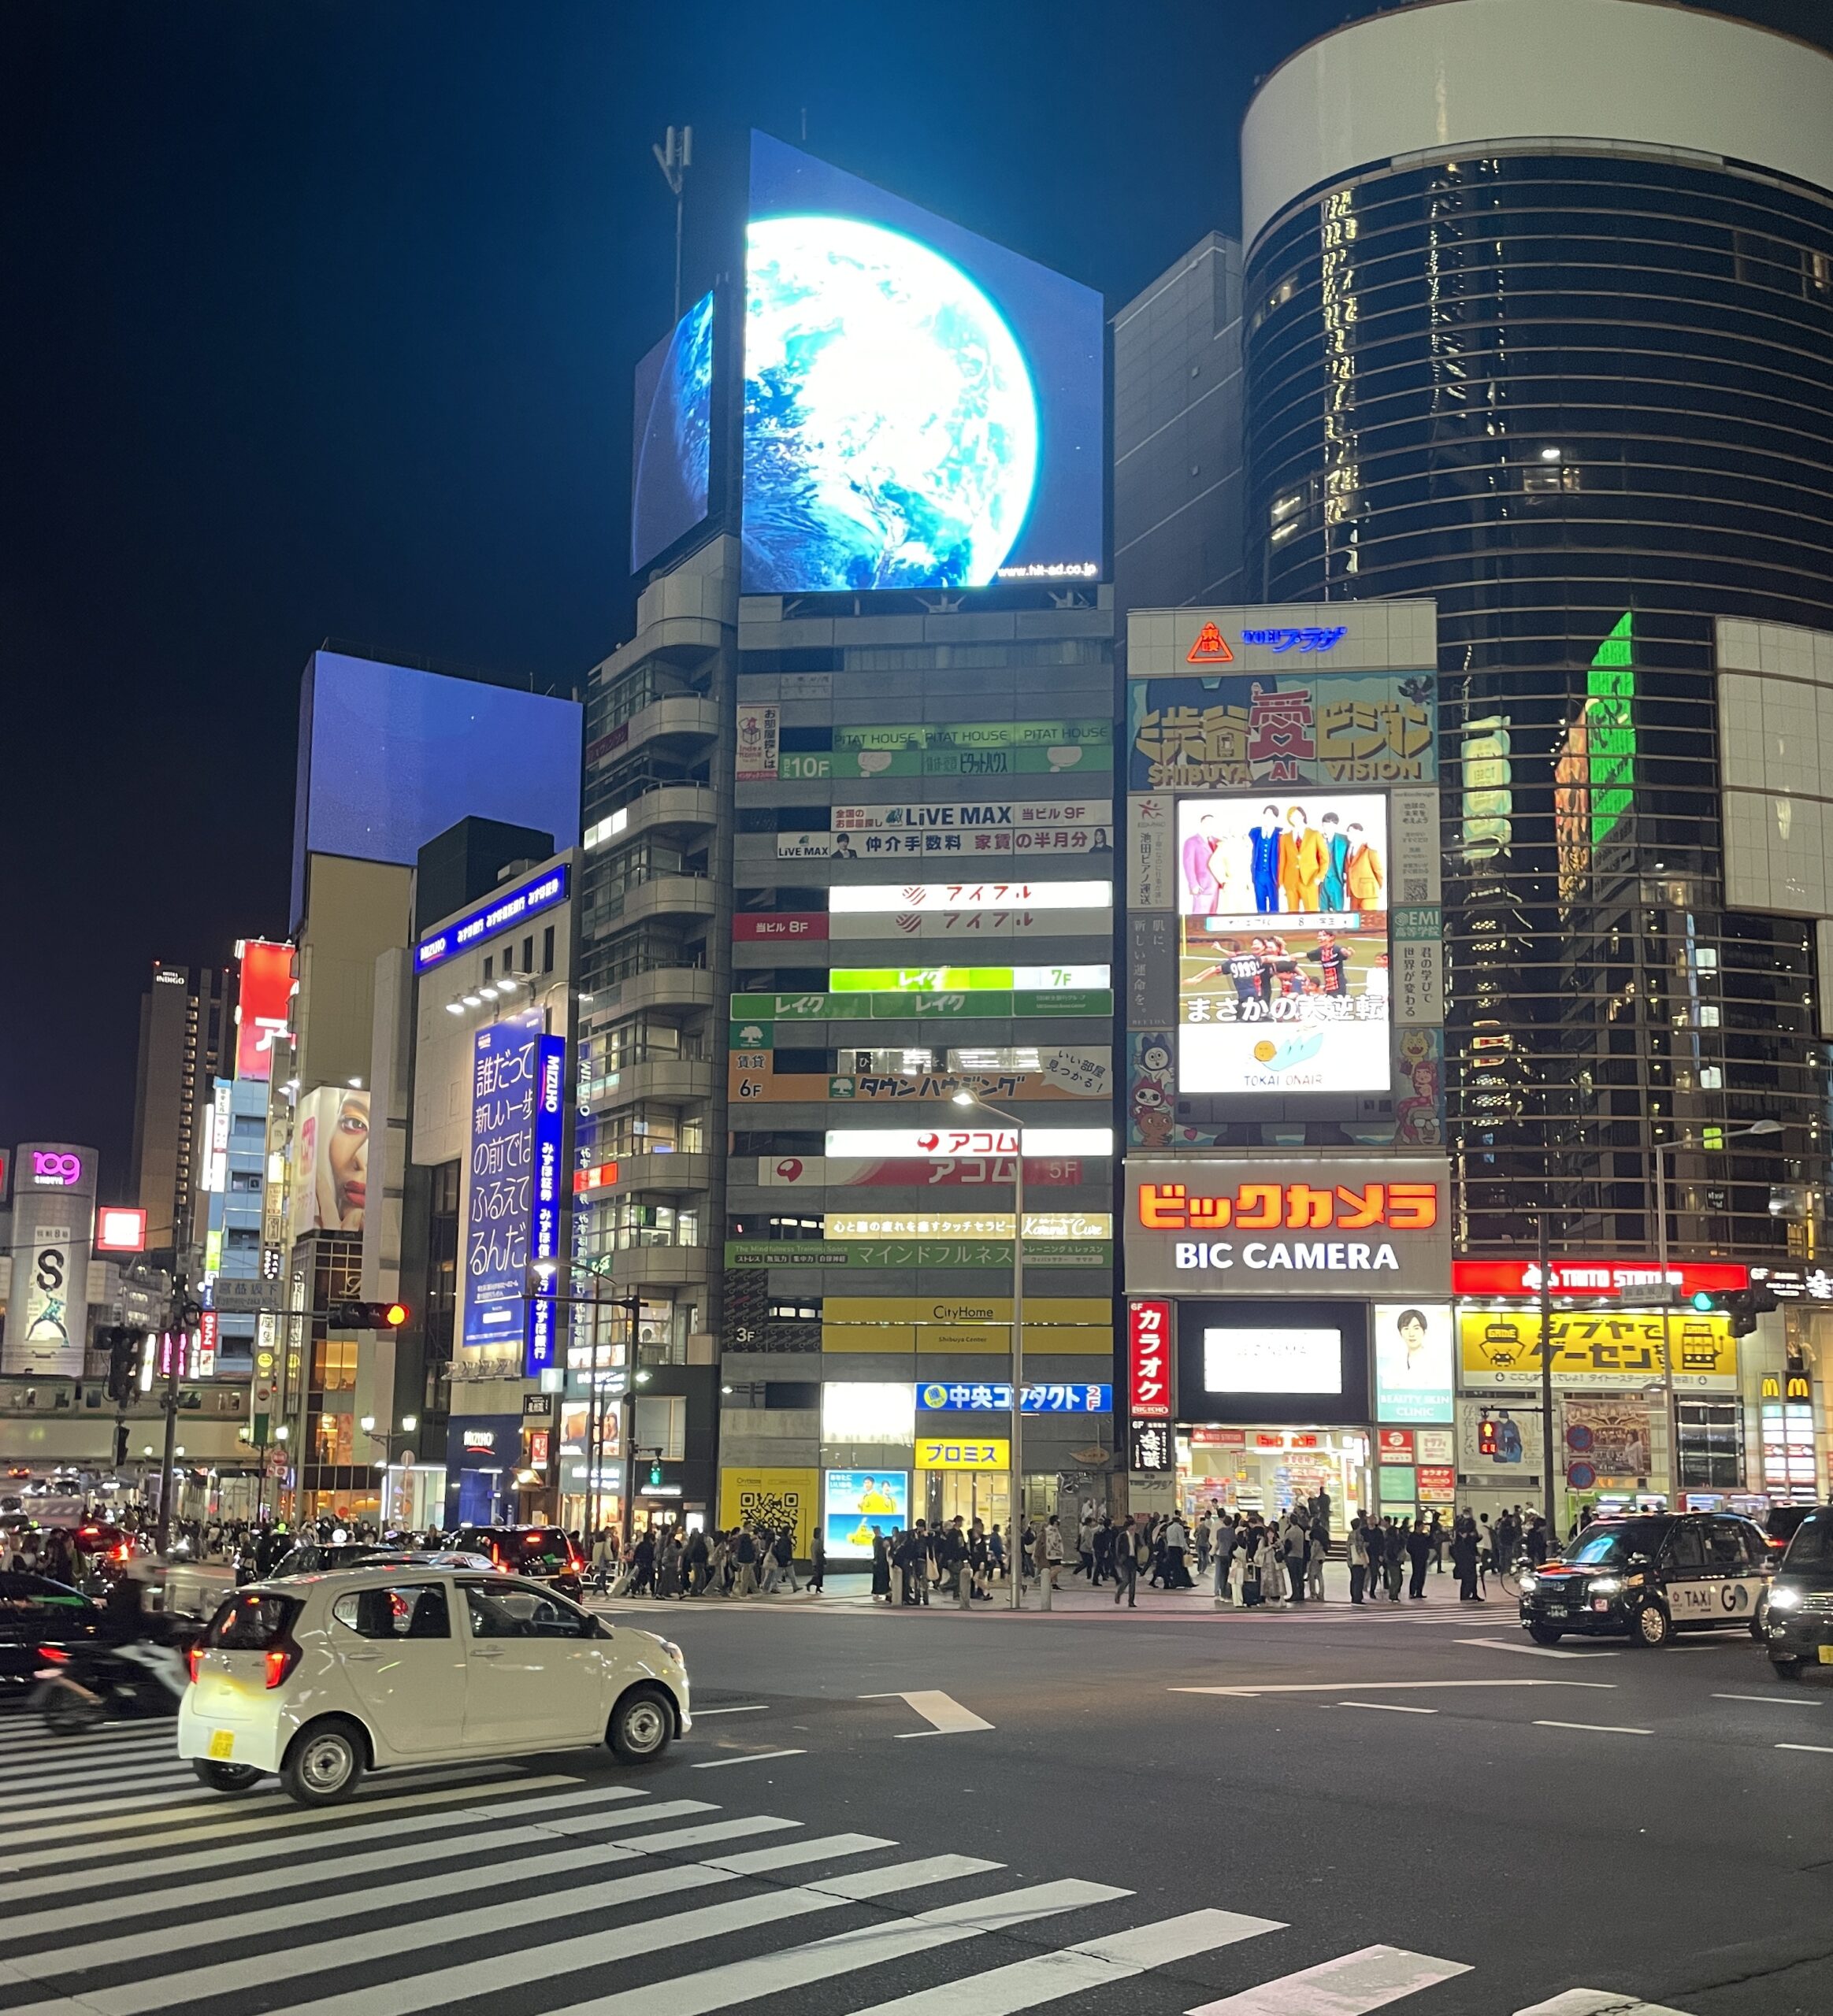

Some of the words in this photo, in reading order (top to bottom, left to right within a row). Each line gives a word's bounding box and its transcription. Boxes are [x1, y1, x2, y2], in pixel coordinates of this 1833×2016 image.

[997, 562, 1097, 576] www.hit-ad.co.jp
[764, 710, 776, 769] お部屋探しは
[835, 733, 866, 747] PITAT
[870, 732, 917, 744] HOUSE
[926, 732, 959, 742] PITAT
[963, 731, 1008, 741] HOUSE
[1024, 728, 1057, 739] PITAT
[1062, 727, 1108, 738] HOUSE
[791, 757, 829, 777] 10F
[1148, 763, 1252, 786] SHIBUYA
[1270, 762, 1297, 780] AI
[1328, 760, 1421, 780] VISION
[836, 810, 864, 818] 全国の
[906, 808, 953, 826] LiVE
[960, 806, 1011, 825] MAX
[1022, 808, 1059, 821] 当ビル
[1063, 807, 1086, 819] 9F
[836, 819, 883, 828] お部屋探し
[866, 835, 962, 852] 仲介手数料
[974, 832, 1088, 850] 家賃の半月分
[1140, 832, 1152, 905] 池田ピアノ運送
[945, 886, 1032, 902] アイフル
[944, 913, 1033, 929] アイフル
[1408, 910, 1440, 925] EMI
[756, 921, 786, 933] 当ビル
[789, 921, 808, 933] 8F
[1152, 919, 1166, 953] 肌に、
[420, 937, 446, 961] MIZUHO
[1134, 920, 1147, 1013] 新しい運命を。
[1420, 946, 1432, 1003] 君の学びで
[899, 969, 947, 987] レイク
[1052, 969, 1072, 986] 7F
[1404, 947, 1415, 1017] 世界が変わる
[775, 995, 824, 1013] レイク
[915, 995, 965, 1012] レイク
[476, 1042, 535, 1099] 誰だって
[737, 1054, 764, 1069] 賃貸
[1058, 1050, 1107, 1079] いい部屋
[545, 1054, 560, 1114] MIZUHO
[739, 1080, 762, 1097] 6F
[859, 1076, 1025, 1097] タウンハウジング
[1244, 1075, 1279, 1086] TOKAI
[475, 1088, 532, 1134] 新しい一歩
[948, 1132, 1018, 1153] アコム
[473, 1128, 531, 1176] の前では
[33, 1151, 81, 1185] 109
[540, 1142, 554, 1201] みずほ証券
[929, 1158, 1017, 1182] アコム
[1049, 1162, 1078, 1178] 5F
[34, 1175, 64, 1185] SHIBUYA
[471, 1176, 529, 1222] ふるえて
[1139, 1184, 1437, 1228] ビックカメラ
[537, 1208, 551, 1292] みずほ信行
[856, 1245, 1013, 1264] マインドフルネス
[1175, 1243, 1233, 1269] BIC
[1241, 1243, 1400, 1269] CAMERA
[1560, 1269, 1610, 1288] TAITO
[1750, 1268, 1769, 1280] 6F
[933, 1305, 993, 1319] CityHome
[1131, 1303, 1143, 1311] 6F
[534, 1299, 548, 1360] みずほ銀行
[736, 1327, 755, 1342] 3F
[1488, 1329, 1516, 1338] GAME
[1685, 1325, 1710, 1334] GAME
[1137, 1310, 1163, 1401] カラオケ
[1509, 1373, 1584, 1383] ここしかいでしょ！
[1590, 1374, 1694, 1384] タイトーステーション谷店！
[1086, 1385, 1101, 1411] 2F
[1380, 1395, 1421, 1404] BEAUTY
[1424, 1395, 1449, 1404] SKIN
[1396, 1407, 1434, 1417] CLINIC
[1132, 1421, 1144, 1429] 6F
[463, 1431, 493, 1447] MIZUHO
[926, 1443, 997, 1462] プロミス
[1684, 1591, 1712, 1606] TAXI
[1720, 1584, 1749, 1612] GO
